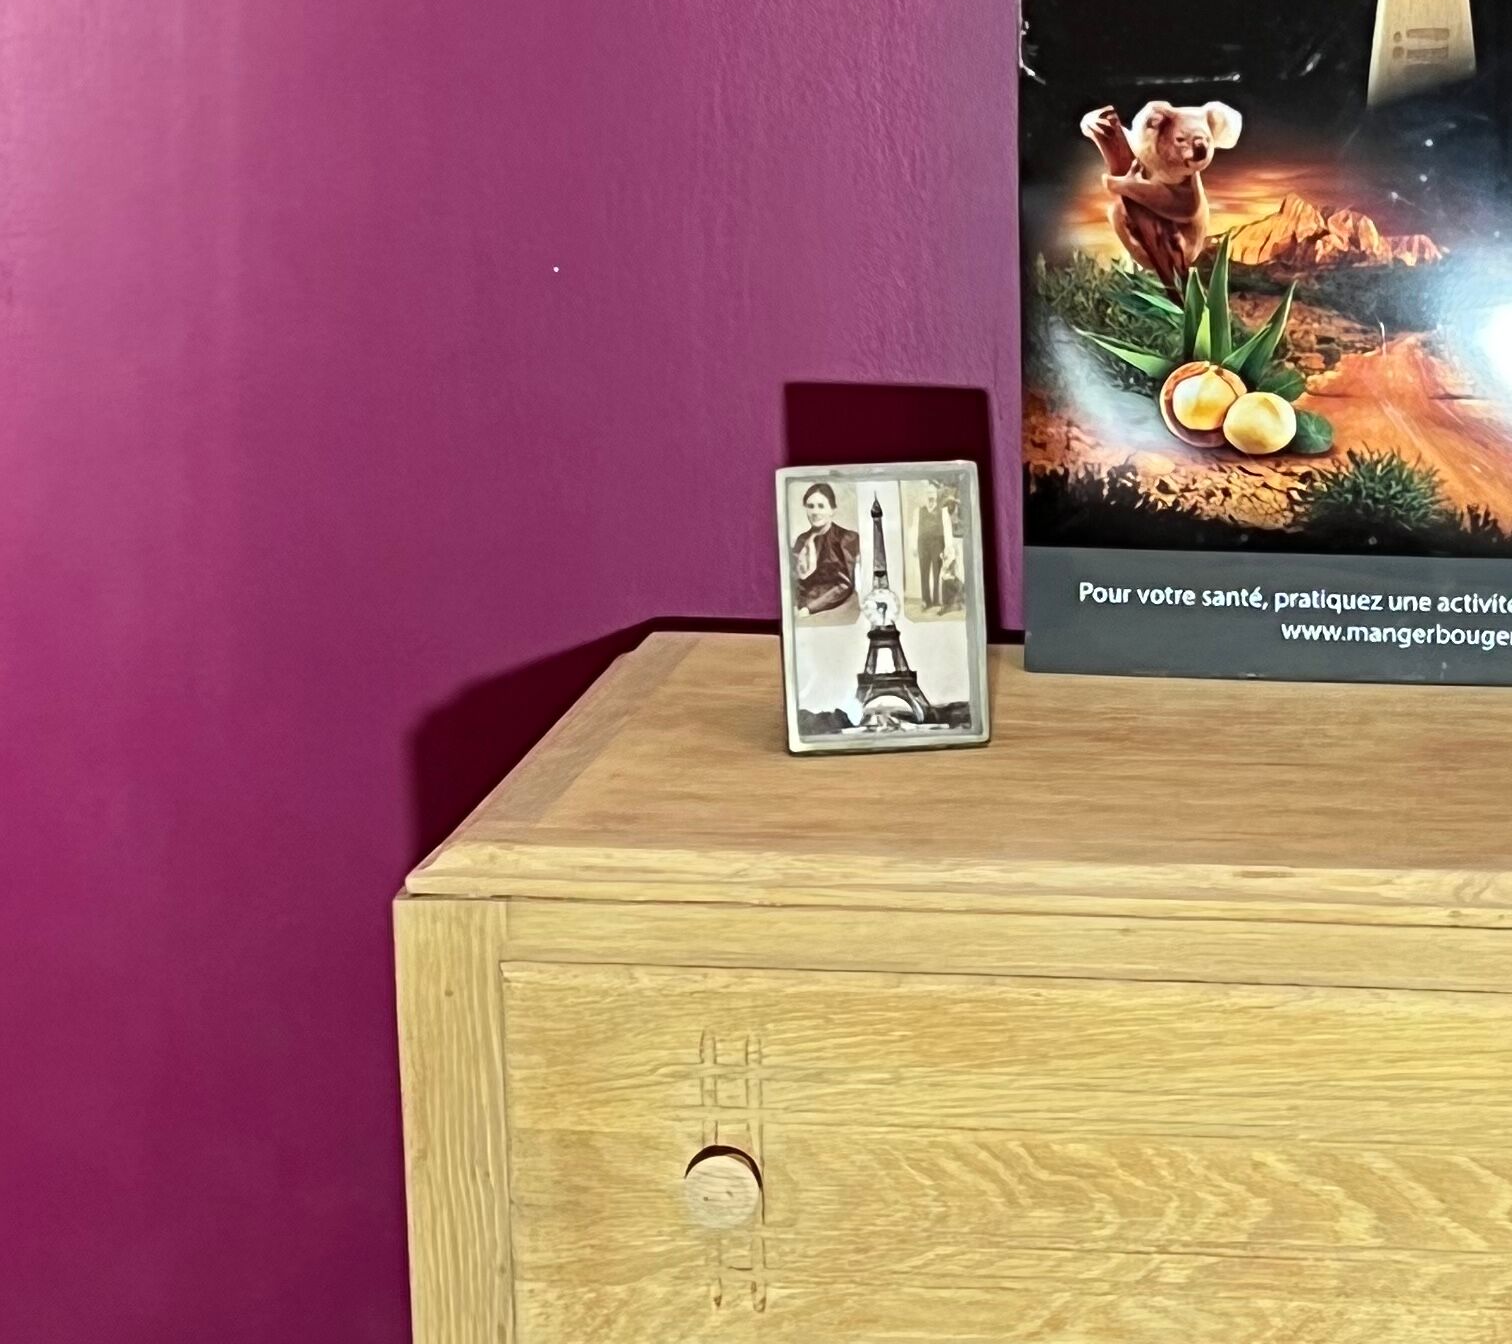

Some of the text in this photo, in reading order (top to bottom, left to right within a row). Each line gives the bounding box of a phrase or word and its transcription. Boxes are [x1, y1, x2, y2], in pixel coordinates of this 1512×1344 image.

[1079, 581, 1131, 604] Pour
[1136, 586, 1196, 606] votre
[1201, 586, 1269, 611] santé,
[1274, 589, 1384, 615] pratiquez
[1388, 595, 1432, 612] une
